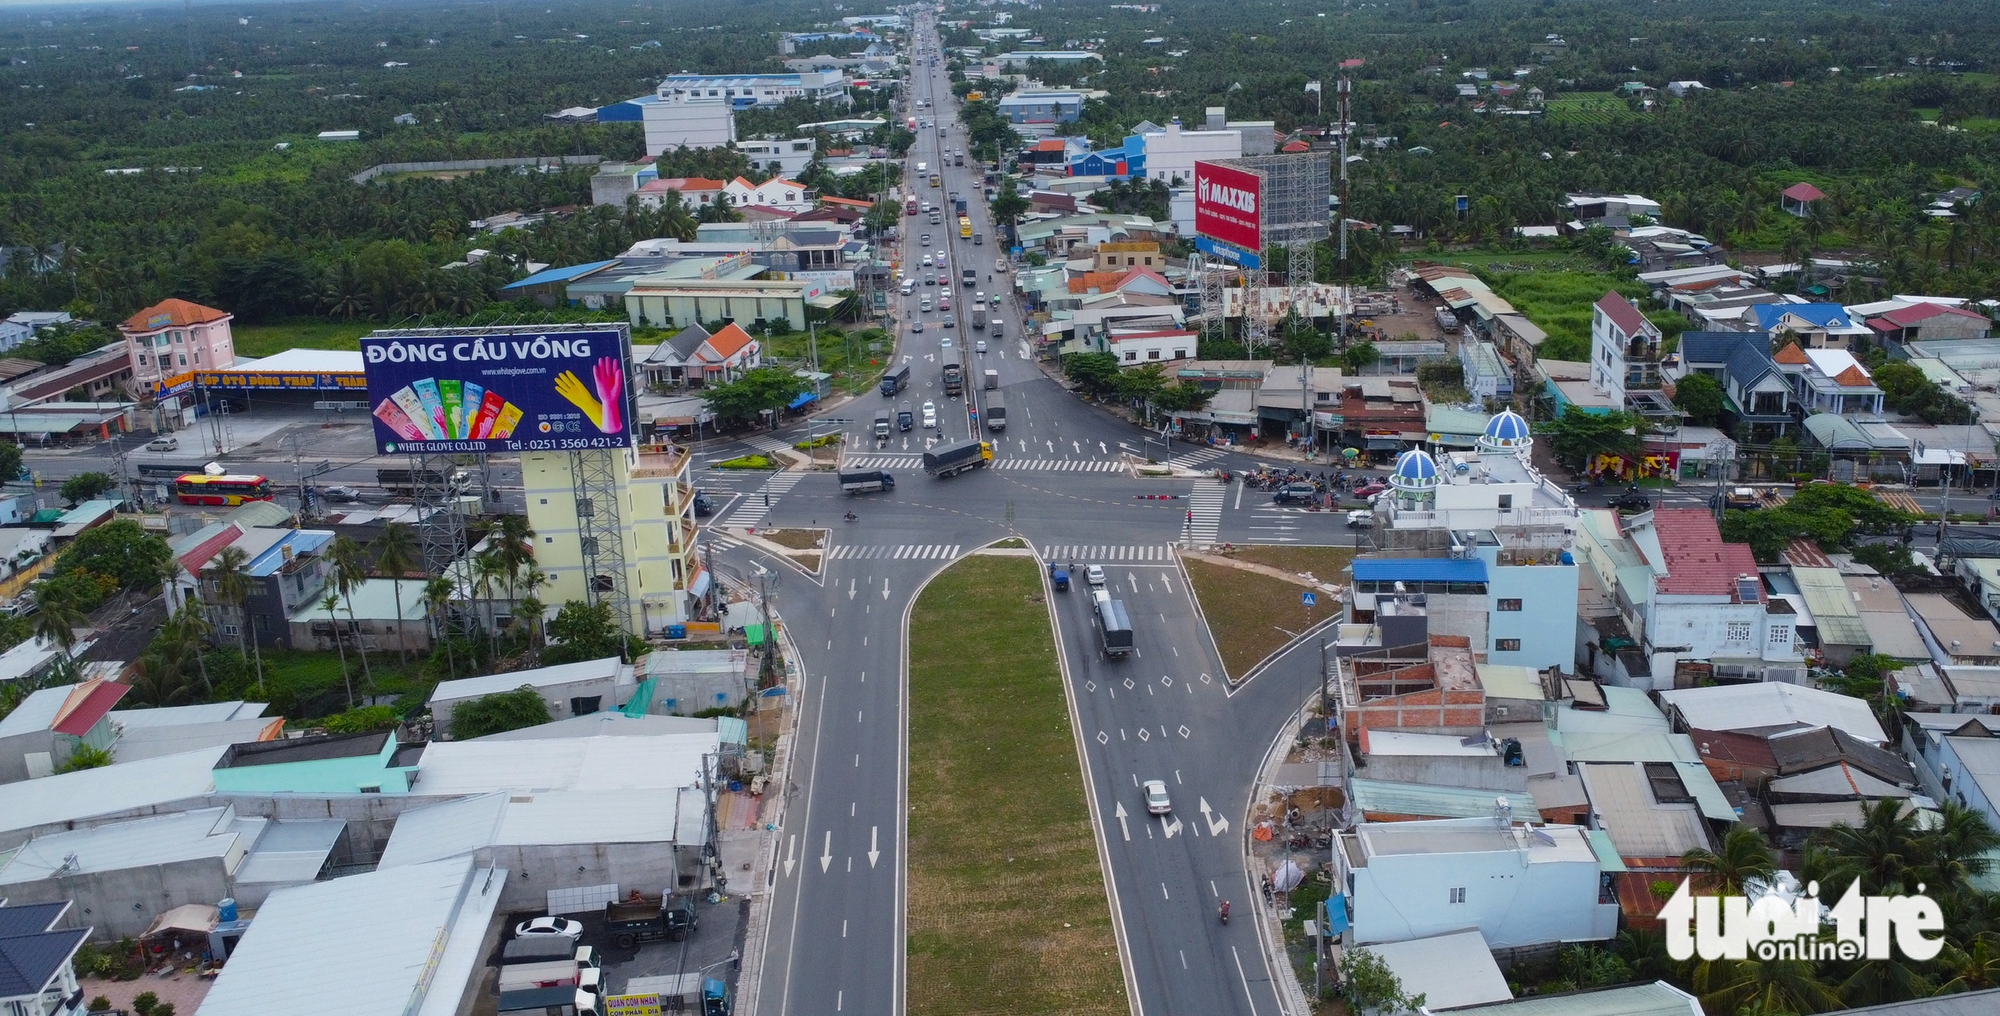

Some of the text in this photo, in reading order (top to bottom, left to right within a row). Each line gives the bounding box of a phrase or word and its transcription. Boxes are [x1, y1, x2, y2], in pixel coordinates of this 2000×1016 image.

[1211, 184, 1256, 213] MAXXIS
[1212, 244, 1240, 261] vinaphone
[366, 335, 591, 363] ĐÔNG CẦU VỒNG
[481, 366, 547, 377] www.whiteglove.com.vn
[398, 442, 426, 452] WHITE
[427, 442, 454, 451] GLOVE
[505, 440, 522, 450] Tel
[530, 440, 556, 449] 0251
[560, 439, 588, 449] 3560
[590, 437, 623, 448] 421-2
